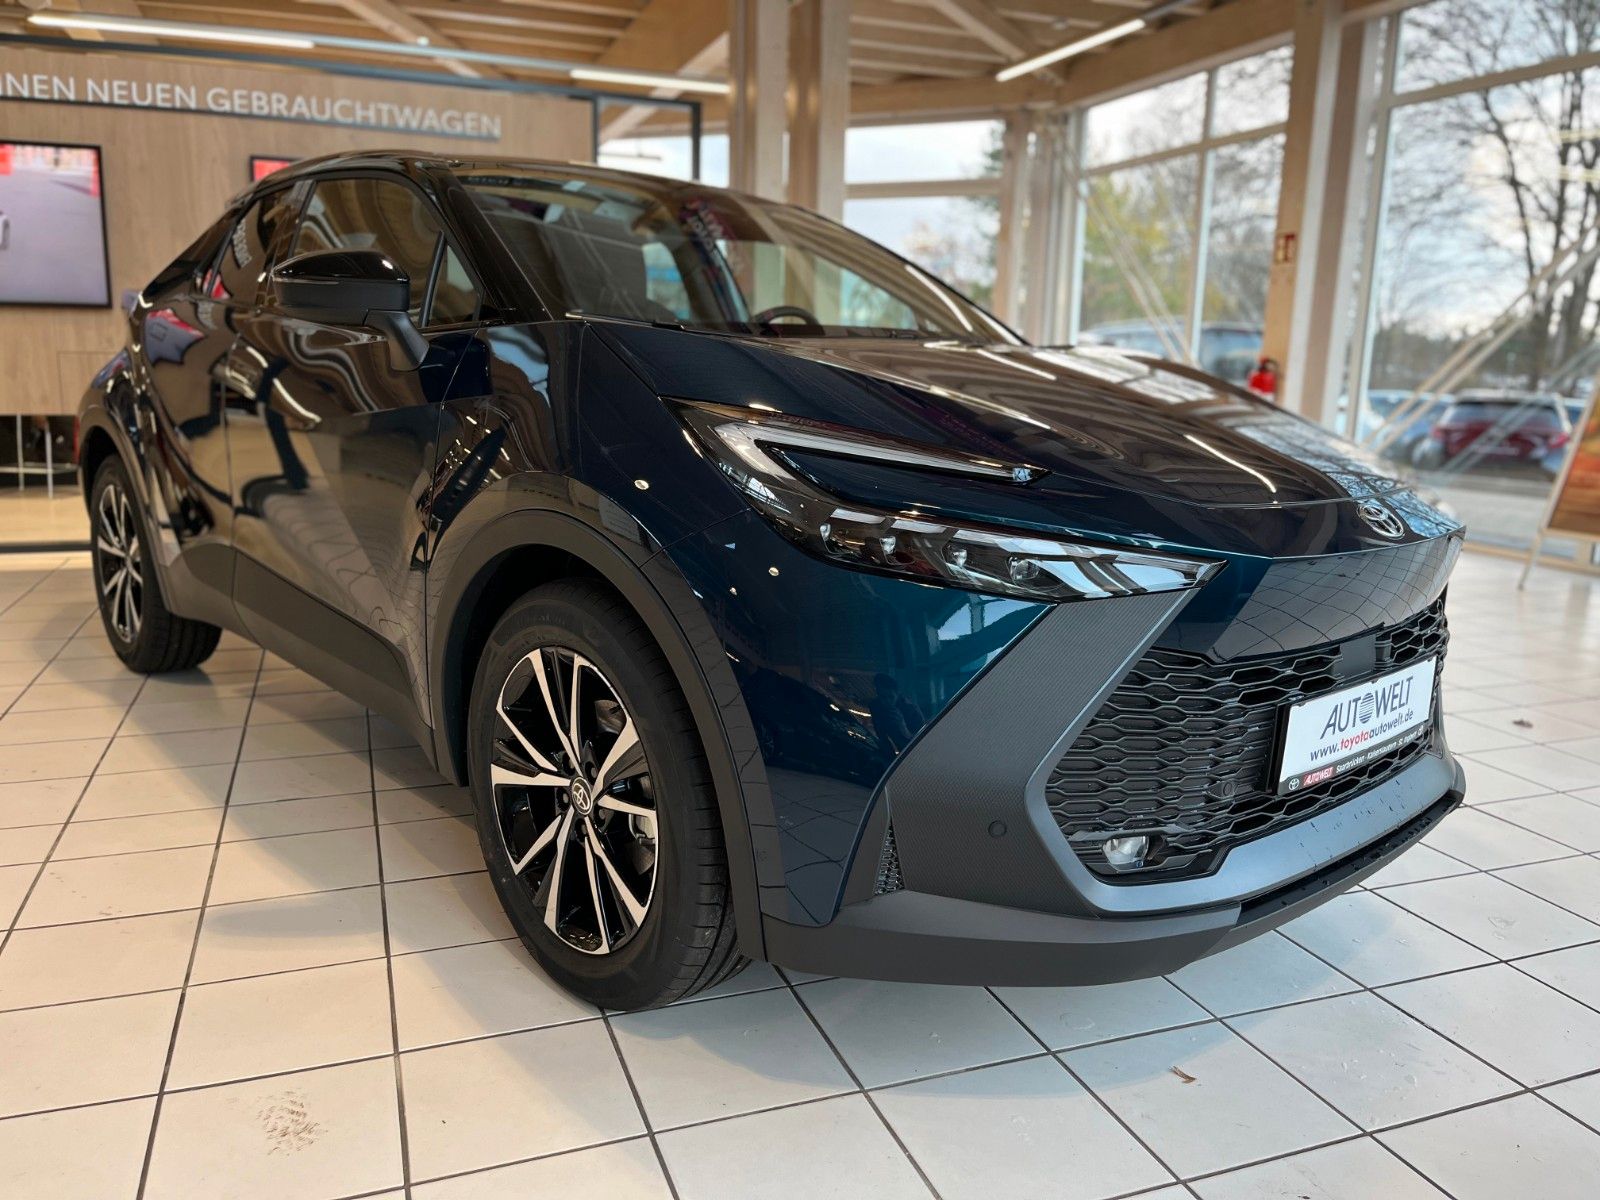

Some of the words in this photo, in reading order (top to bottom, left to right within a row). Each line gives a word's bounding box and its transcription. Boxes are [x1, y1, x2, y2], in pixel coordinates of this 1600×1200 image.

[86, 78, 196, 109] NEUEN
[205, 87, 500, 137] GEBRAUCHTWAGEN
[1310, 708, 1413, 761] www.toyotaautowelt.de
[1320, 676, 1413, 740] AUTOWELT
